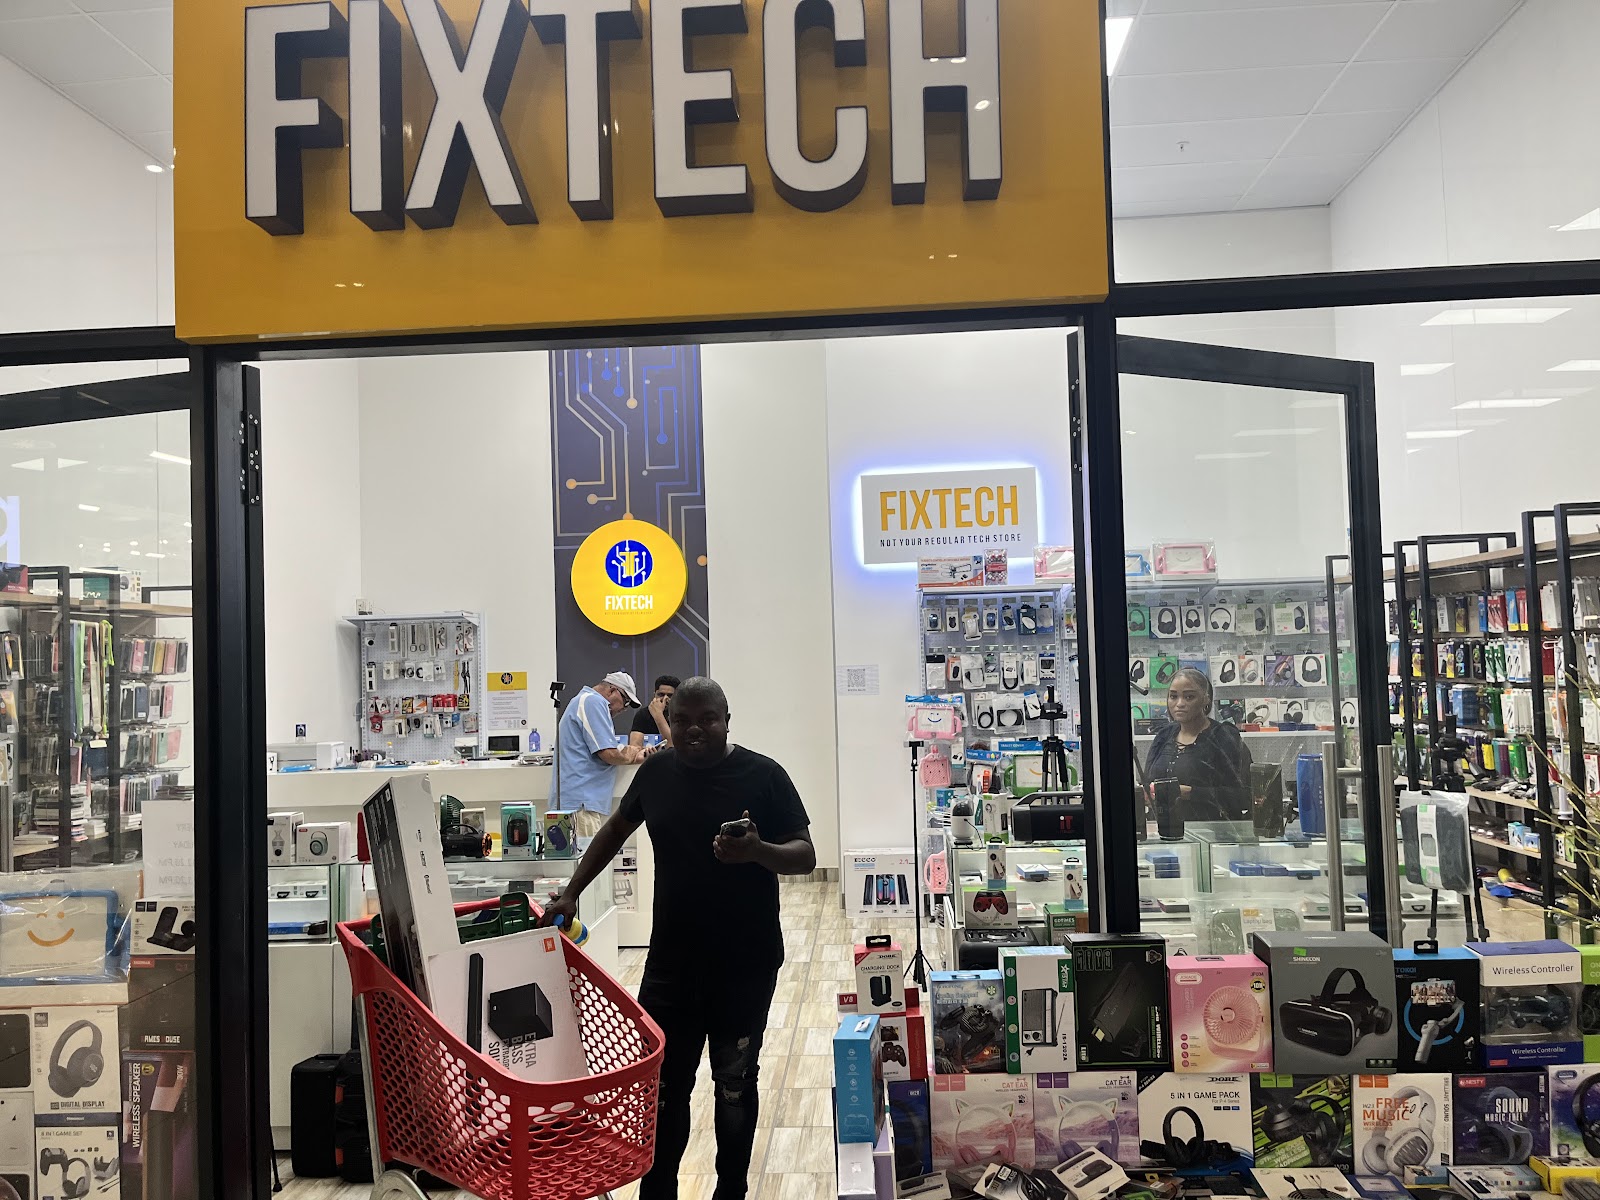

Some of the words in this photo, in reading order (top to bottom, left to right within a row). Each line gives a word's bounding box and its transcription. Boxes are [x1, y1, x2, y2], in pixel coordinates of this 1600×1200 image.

[243, 0, 1002, 228] FIXTECH
[879, 485, 1019, 531] FIXTECH
[880, 538, 897, 547] NOT
[899, 537, 922, 547] YOUR
[924, 535, 965, 546] REGULAR
[967, 533, 990, 544] TECH
[993, 533, 1021, 542] STORE
[605, 595, 653, 610] FIXTECH
[1492, 966, 1530, 975] Wireless
[1530, 963, 1574, 974] Controller
[843, 995, 854, 1003] V8
[511, 1035, 523, 1065] BASS
[525, 1032, 536, 1069] EXTRA
[1537, 1046, 1566, 1054] Controller
[132, 1062, 141, 1102] SPEAKER
[1193, 1091, 1217, 1099] GAME
[1375, 1097, 1409, 1109] FREE
[1495, 1097, 1529, 1113] SOUND
[1362, 1109, 1410, 1121] MUSIC
[132, 1104, 141, 1148] WIRELESS
